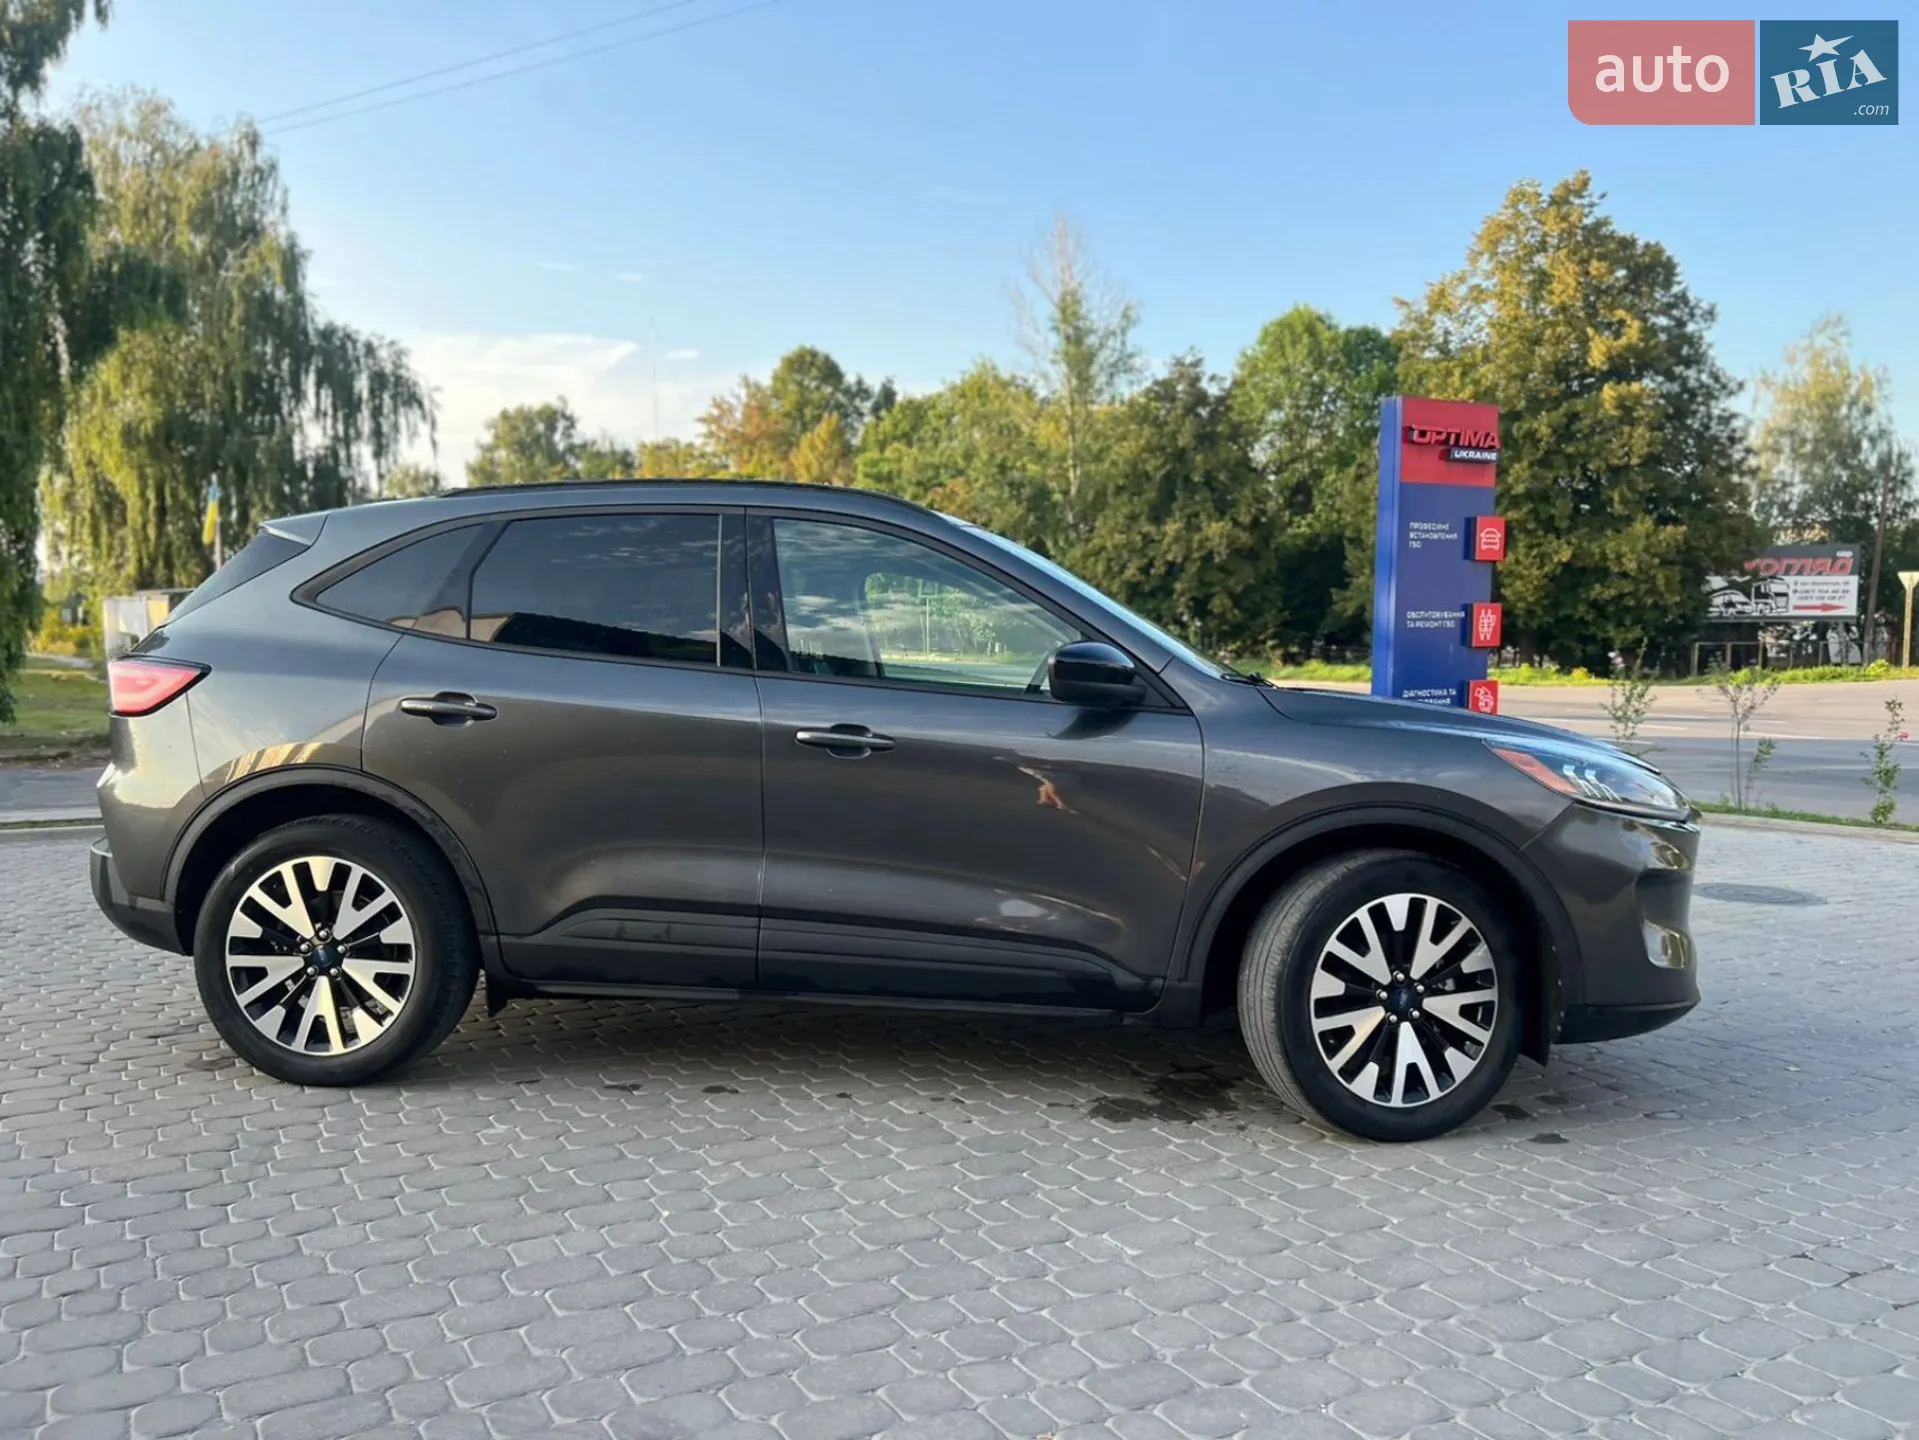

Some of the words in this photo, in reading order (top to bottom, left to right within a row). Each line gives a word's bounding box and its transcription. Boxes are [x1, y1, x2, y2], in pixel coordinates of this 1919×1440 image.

[1411, 424, 1500, 449] OPTIMA
[1453, 449, 1498, 460] UKRAINE
[1406, 620, 1415, 628] ТА
[1415, 620, 1442, 628] РЕМОНТ
